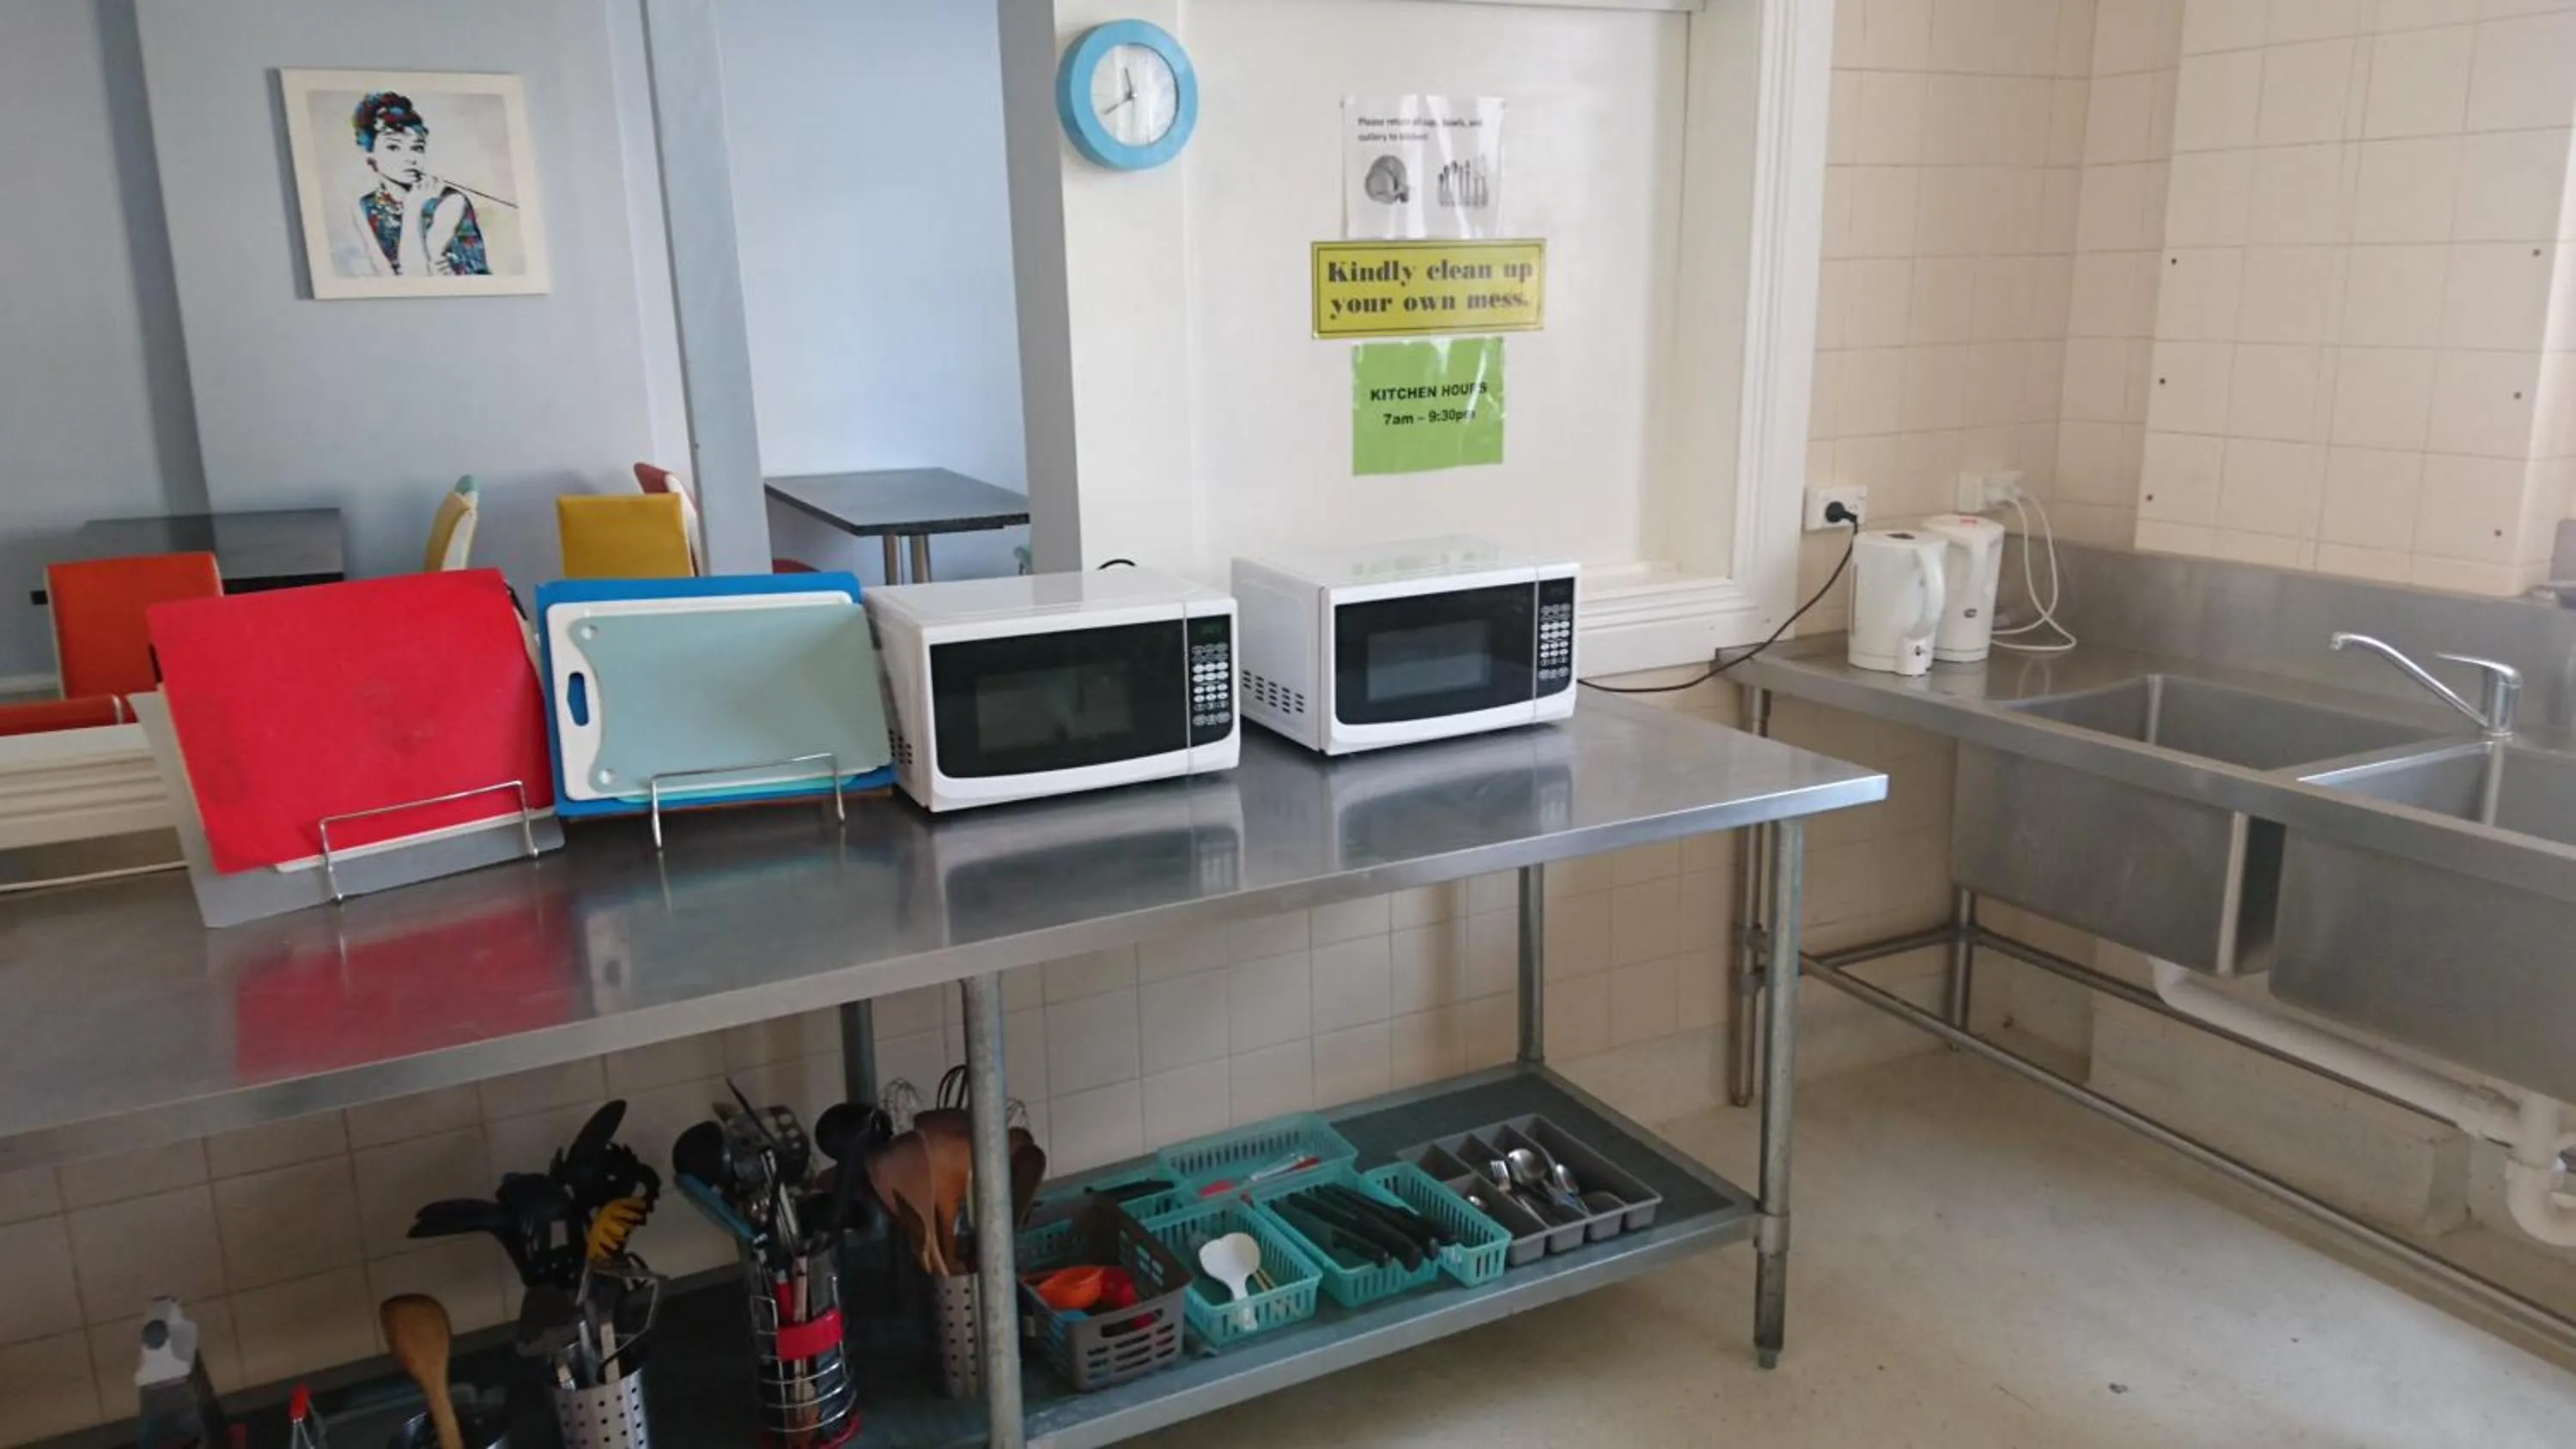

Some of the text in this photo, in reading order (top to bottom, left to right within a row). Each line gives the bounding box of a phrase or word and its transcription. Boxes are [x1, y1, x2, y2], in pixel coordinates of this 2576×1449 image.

[1358, 117, 1384, 126] Please
[1328, 259, 1533, 287] Kindly clean up
[1330, 290, 1529, 320] your own mess.
[1370, 386, 1437, 402] KITCHEN
[1383, 411, 1414, 426] 7am
